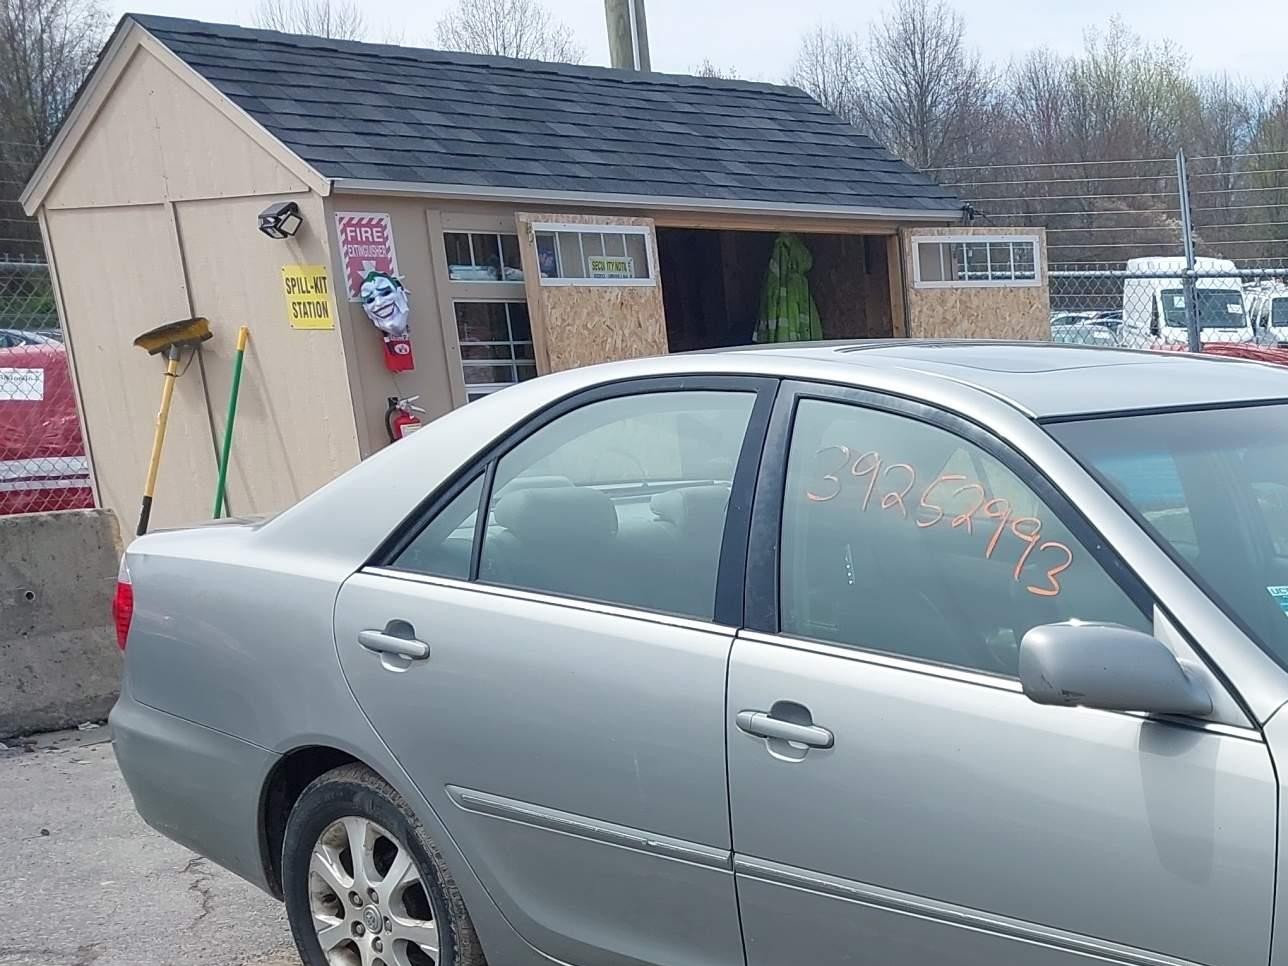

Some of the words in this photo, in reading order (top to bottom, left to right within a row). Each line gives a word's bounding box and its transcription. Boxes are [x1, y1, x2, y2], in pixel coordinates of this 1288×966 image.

[346, 227, 384, 242] FIRE
[347, 244, 387, 257] EXTINGUISHER
[615, 260, 632, 272] NOTIE
[285, 276, 329, 295] SPILL-KIT
[292, 300, 330, 320] STATION
[807, 444, 1074, 598] 39252993
